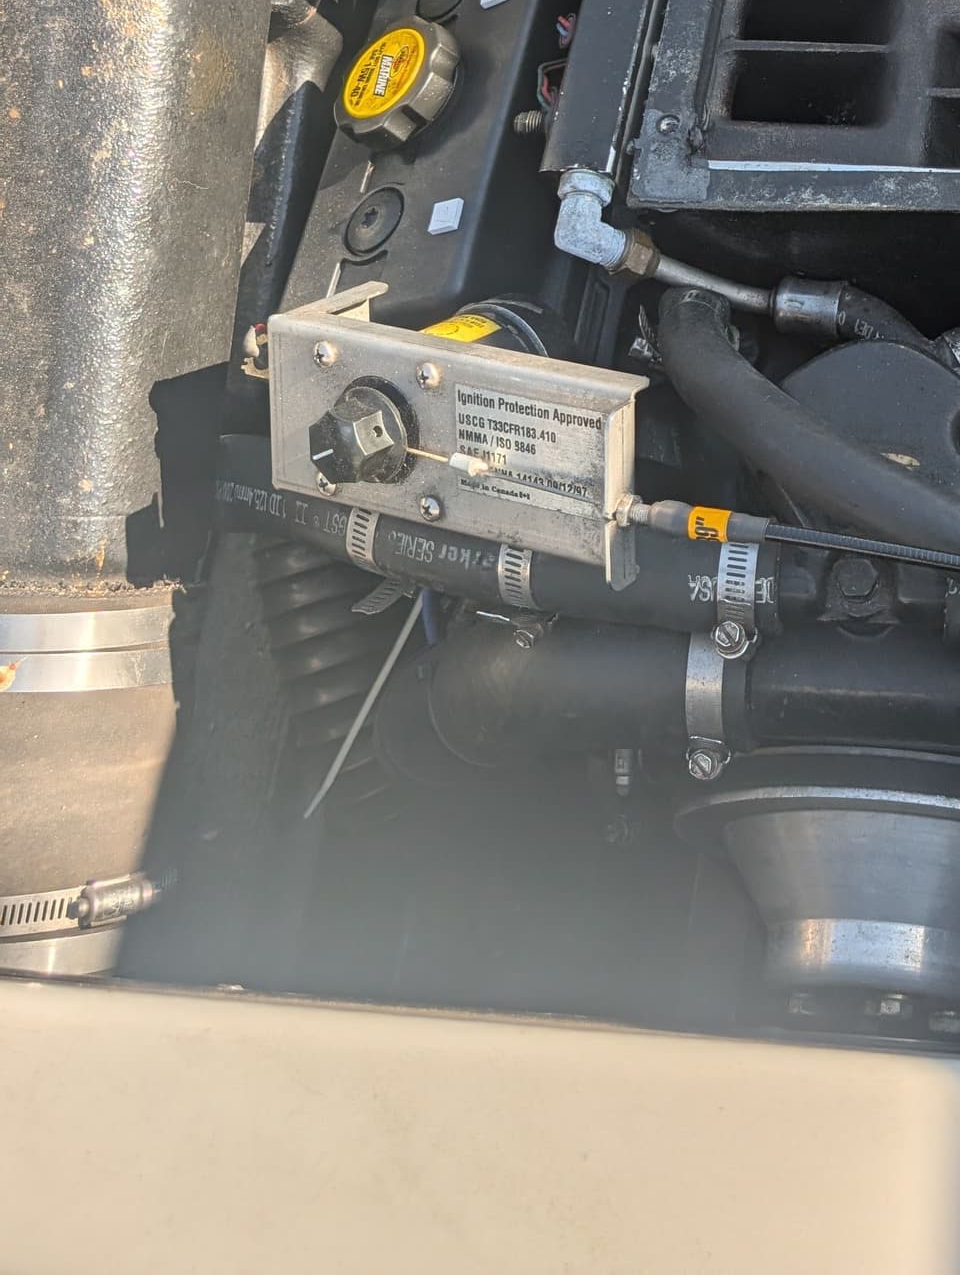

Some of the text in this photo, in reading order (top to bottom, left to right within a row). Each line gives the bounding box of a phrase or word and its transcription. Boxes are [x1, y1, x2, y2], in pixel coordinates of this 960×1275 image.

[350, 62, 372, 98] 15W-40
[374, 54, 394, 97] MARINE
[458, 390, 602, 430] Ignition Protection Approved
[458, 413, 556, 443] USCG T33CFR183.410
[458, 430, 488, 446] NMMA
[496, 438, 512, 450] ISO
[492, 486, 518, 498] Canada
[388, 530, 434, 563] SERIE
[438, 544, 495, 570] arker
